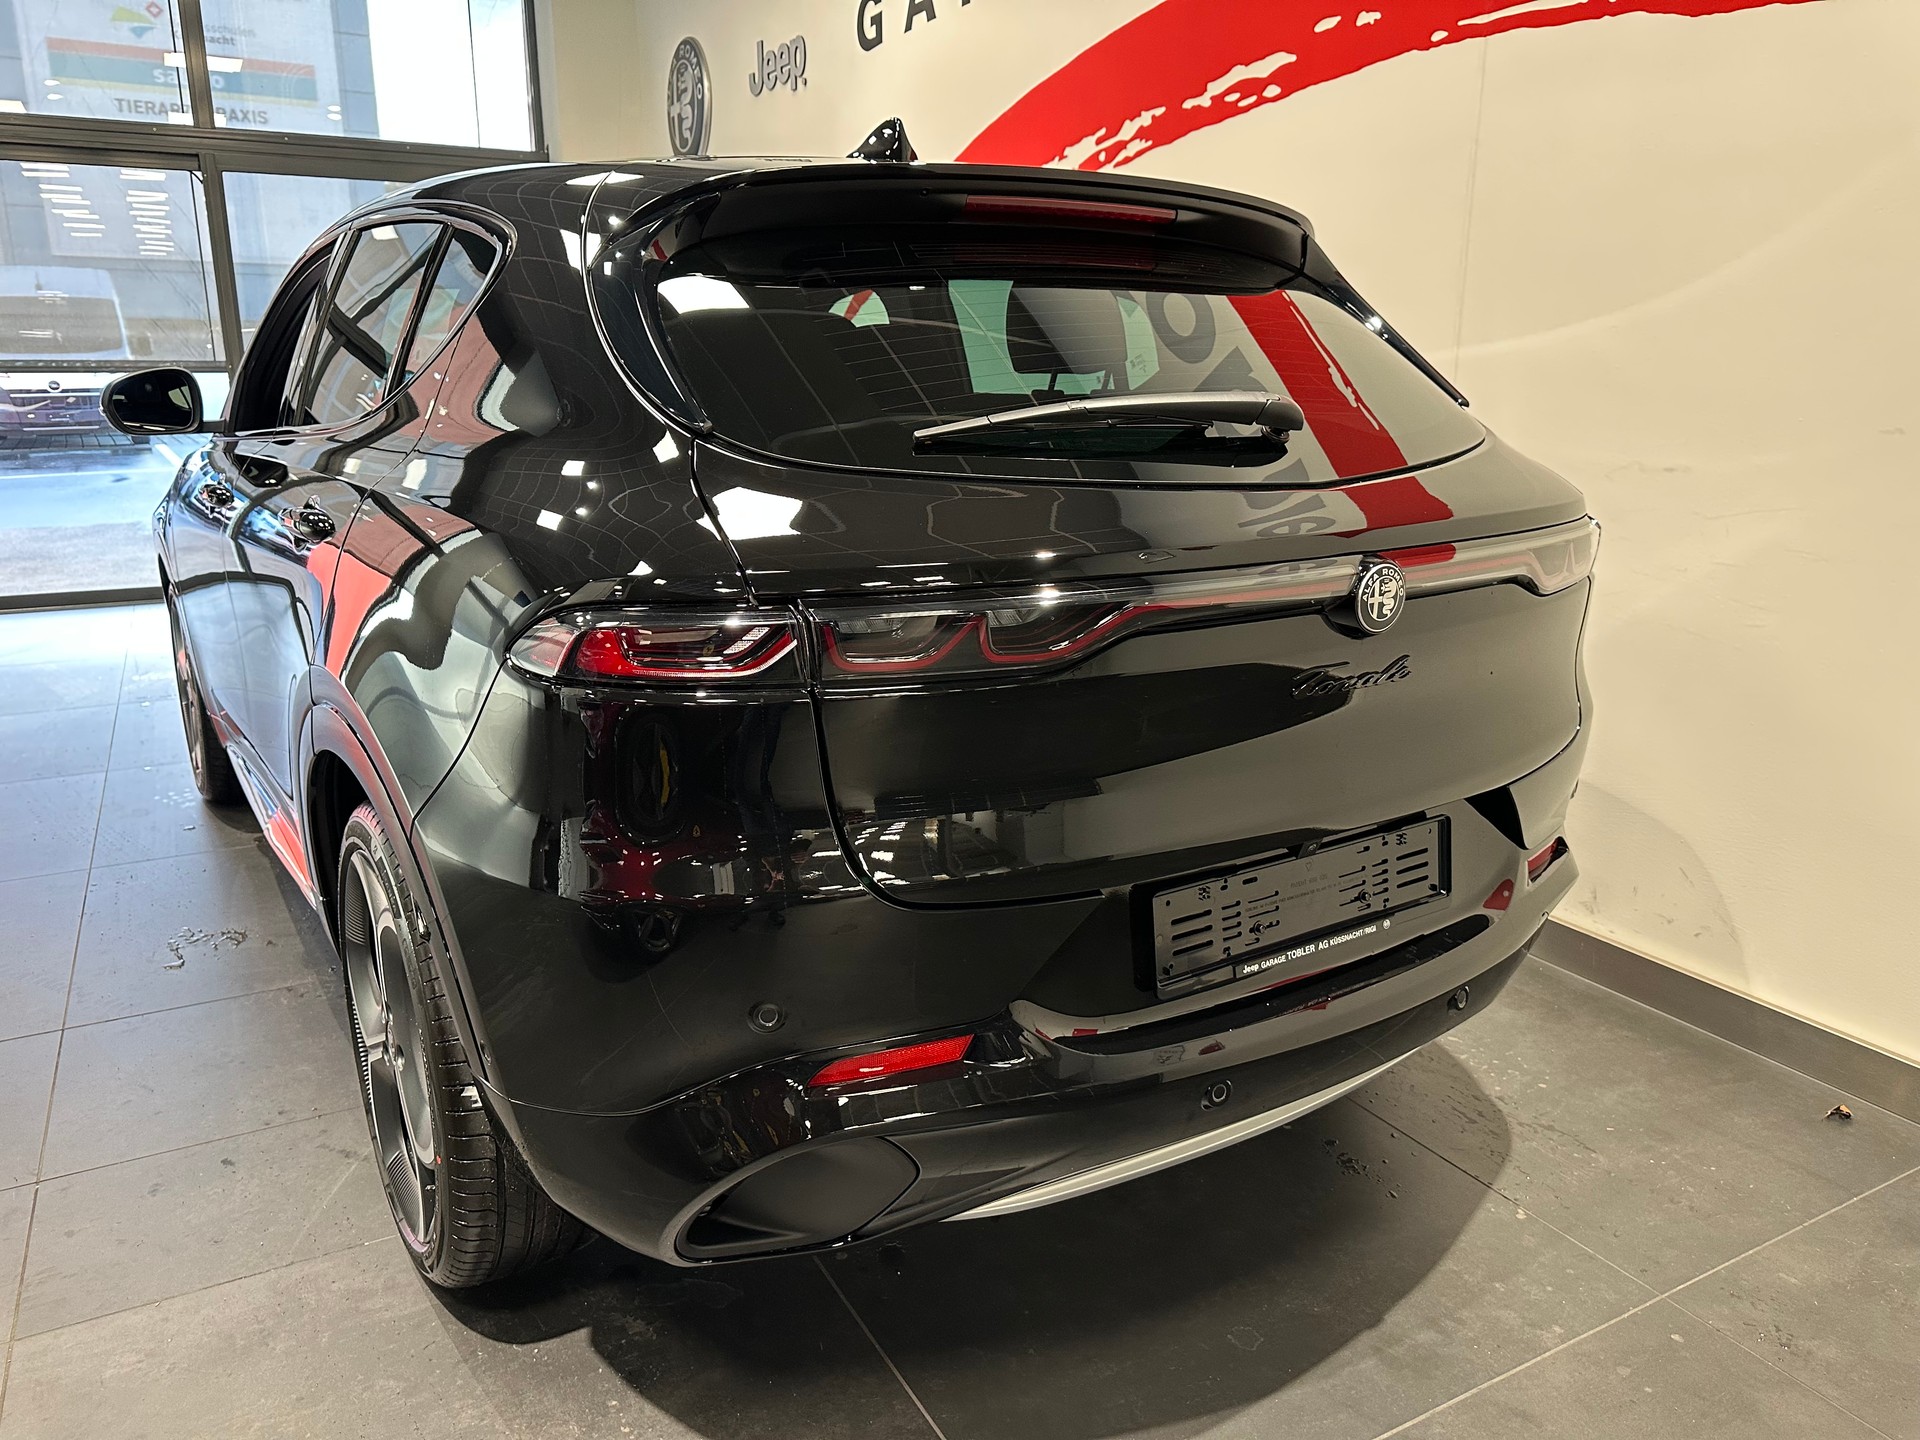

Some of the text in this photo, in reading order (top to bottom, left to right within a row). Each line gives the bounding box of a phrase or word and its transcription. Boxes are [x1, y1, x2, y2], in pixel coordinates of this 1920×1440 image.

[857, 0, 971, 52] GA
[748, 35, 807, 97] Jeep
[1362, 568, 1404, 602] ALFA ROMEO
[1290, 654, 1412, 699] Tonale
[1242, 963, 1260, 974] Jeep
[1260, 953, 1287, 969] GARAGE
[1286, 943, 1316, 961] TOBLER
[1317, 939, 1329, 951] AG
